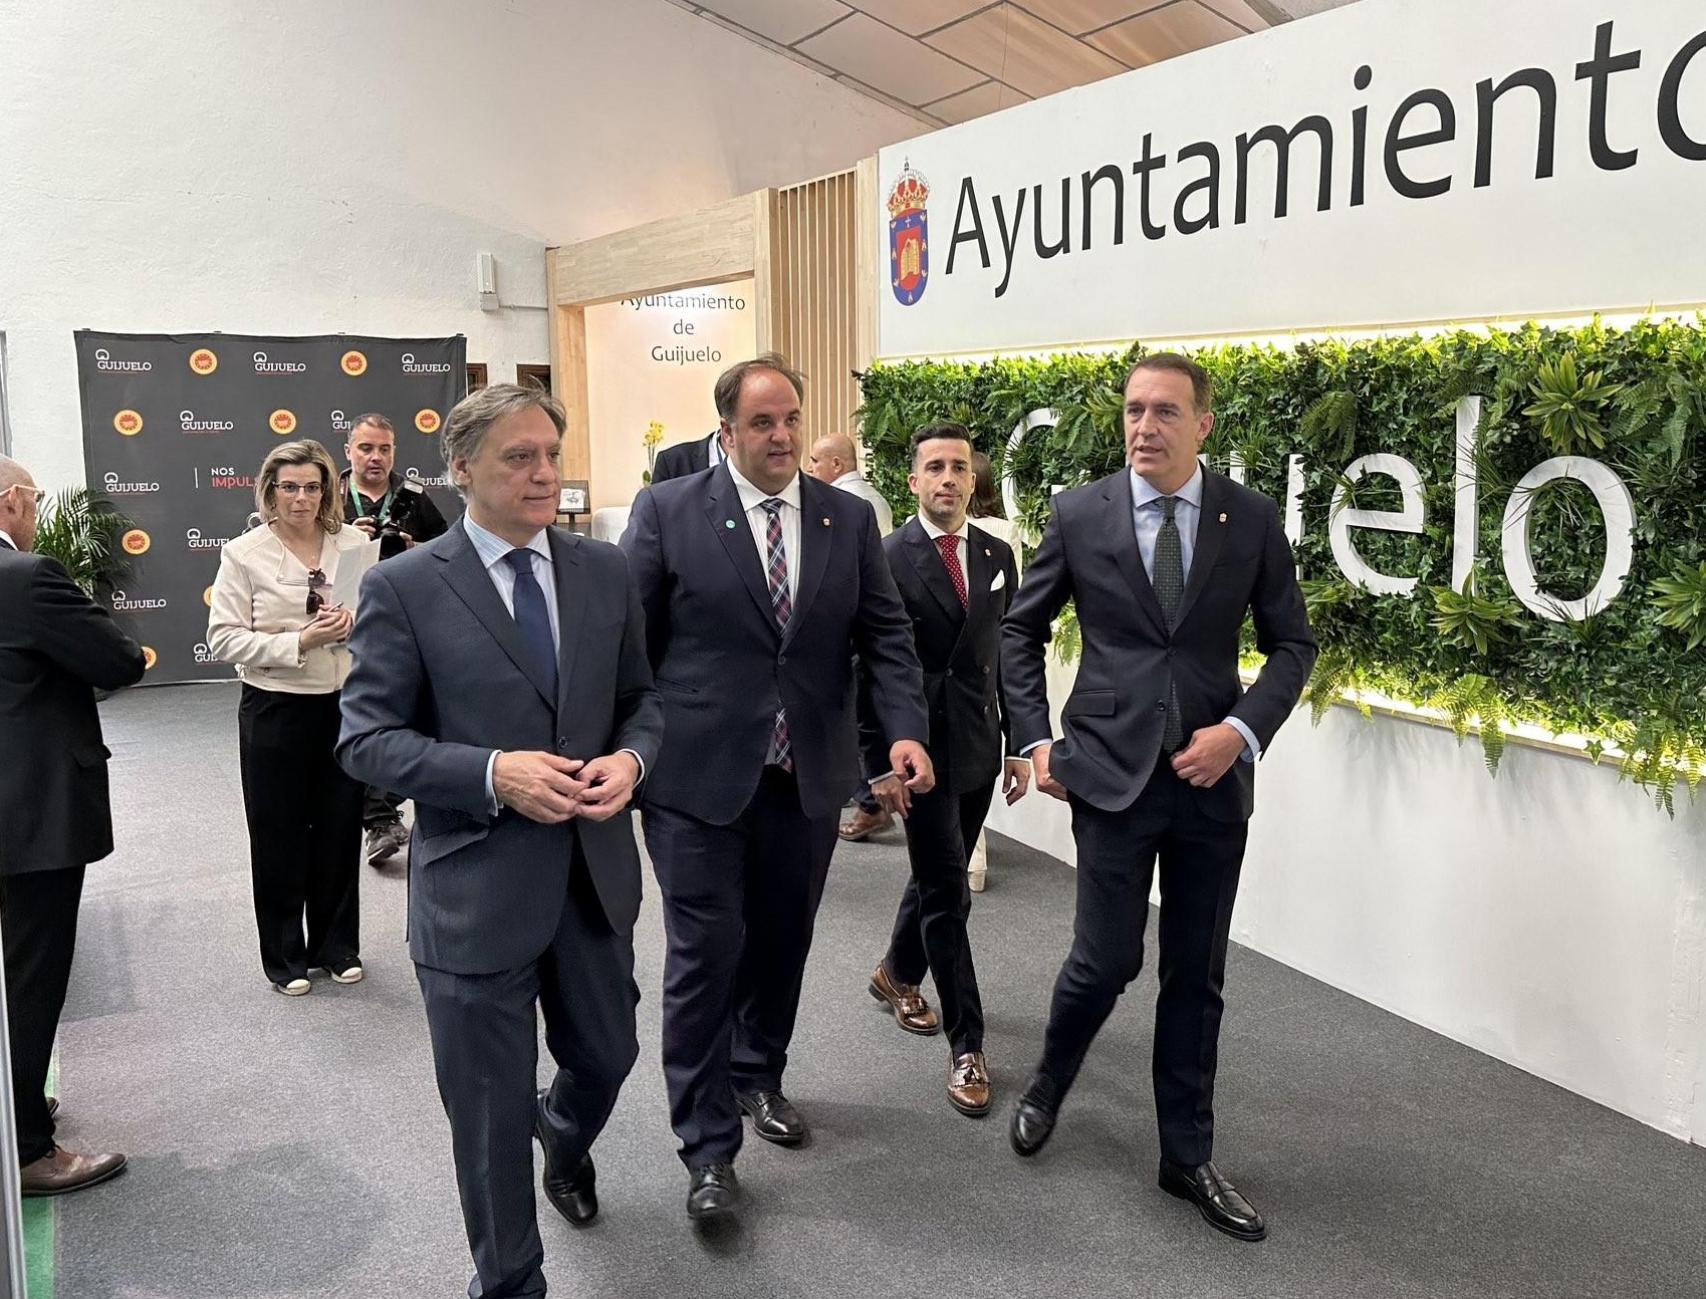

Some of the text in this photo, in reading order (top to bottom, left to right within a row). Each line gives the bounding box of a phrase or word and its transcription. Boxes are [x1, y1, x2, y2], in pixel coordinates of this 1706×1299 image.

[673, 318, 695, 335] de
[651, 345, 722, 366] Guijuelo
[97, 360, 152, 371] GUIJUELO
[254, 362, 306, 373] GUIJUELO
[402, 363, 451, 373] GUIJUELO
[181, 421, 234, 431] GUIJUELO
[211, 467, 235, 476] NOS
[105, 482, 160, 493] GUIJUELO
[212, 476, 255, 489] IMPUL
[113, 599, 167, 610] GUIJUELO
